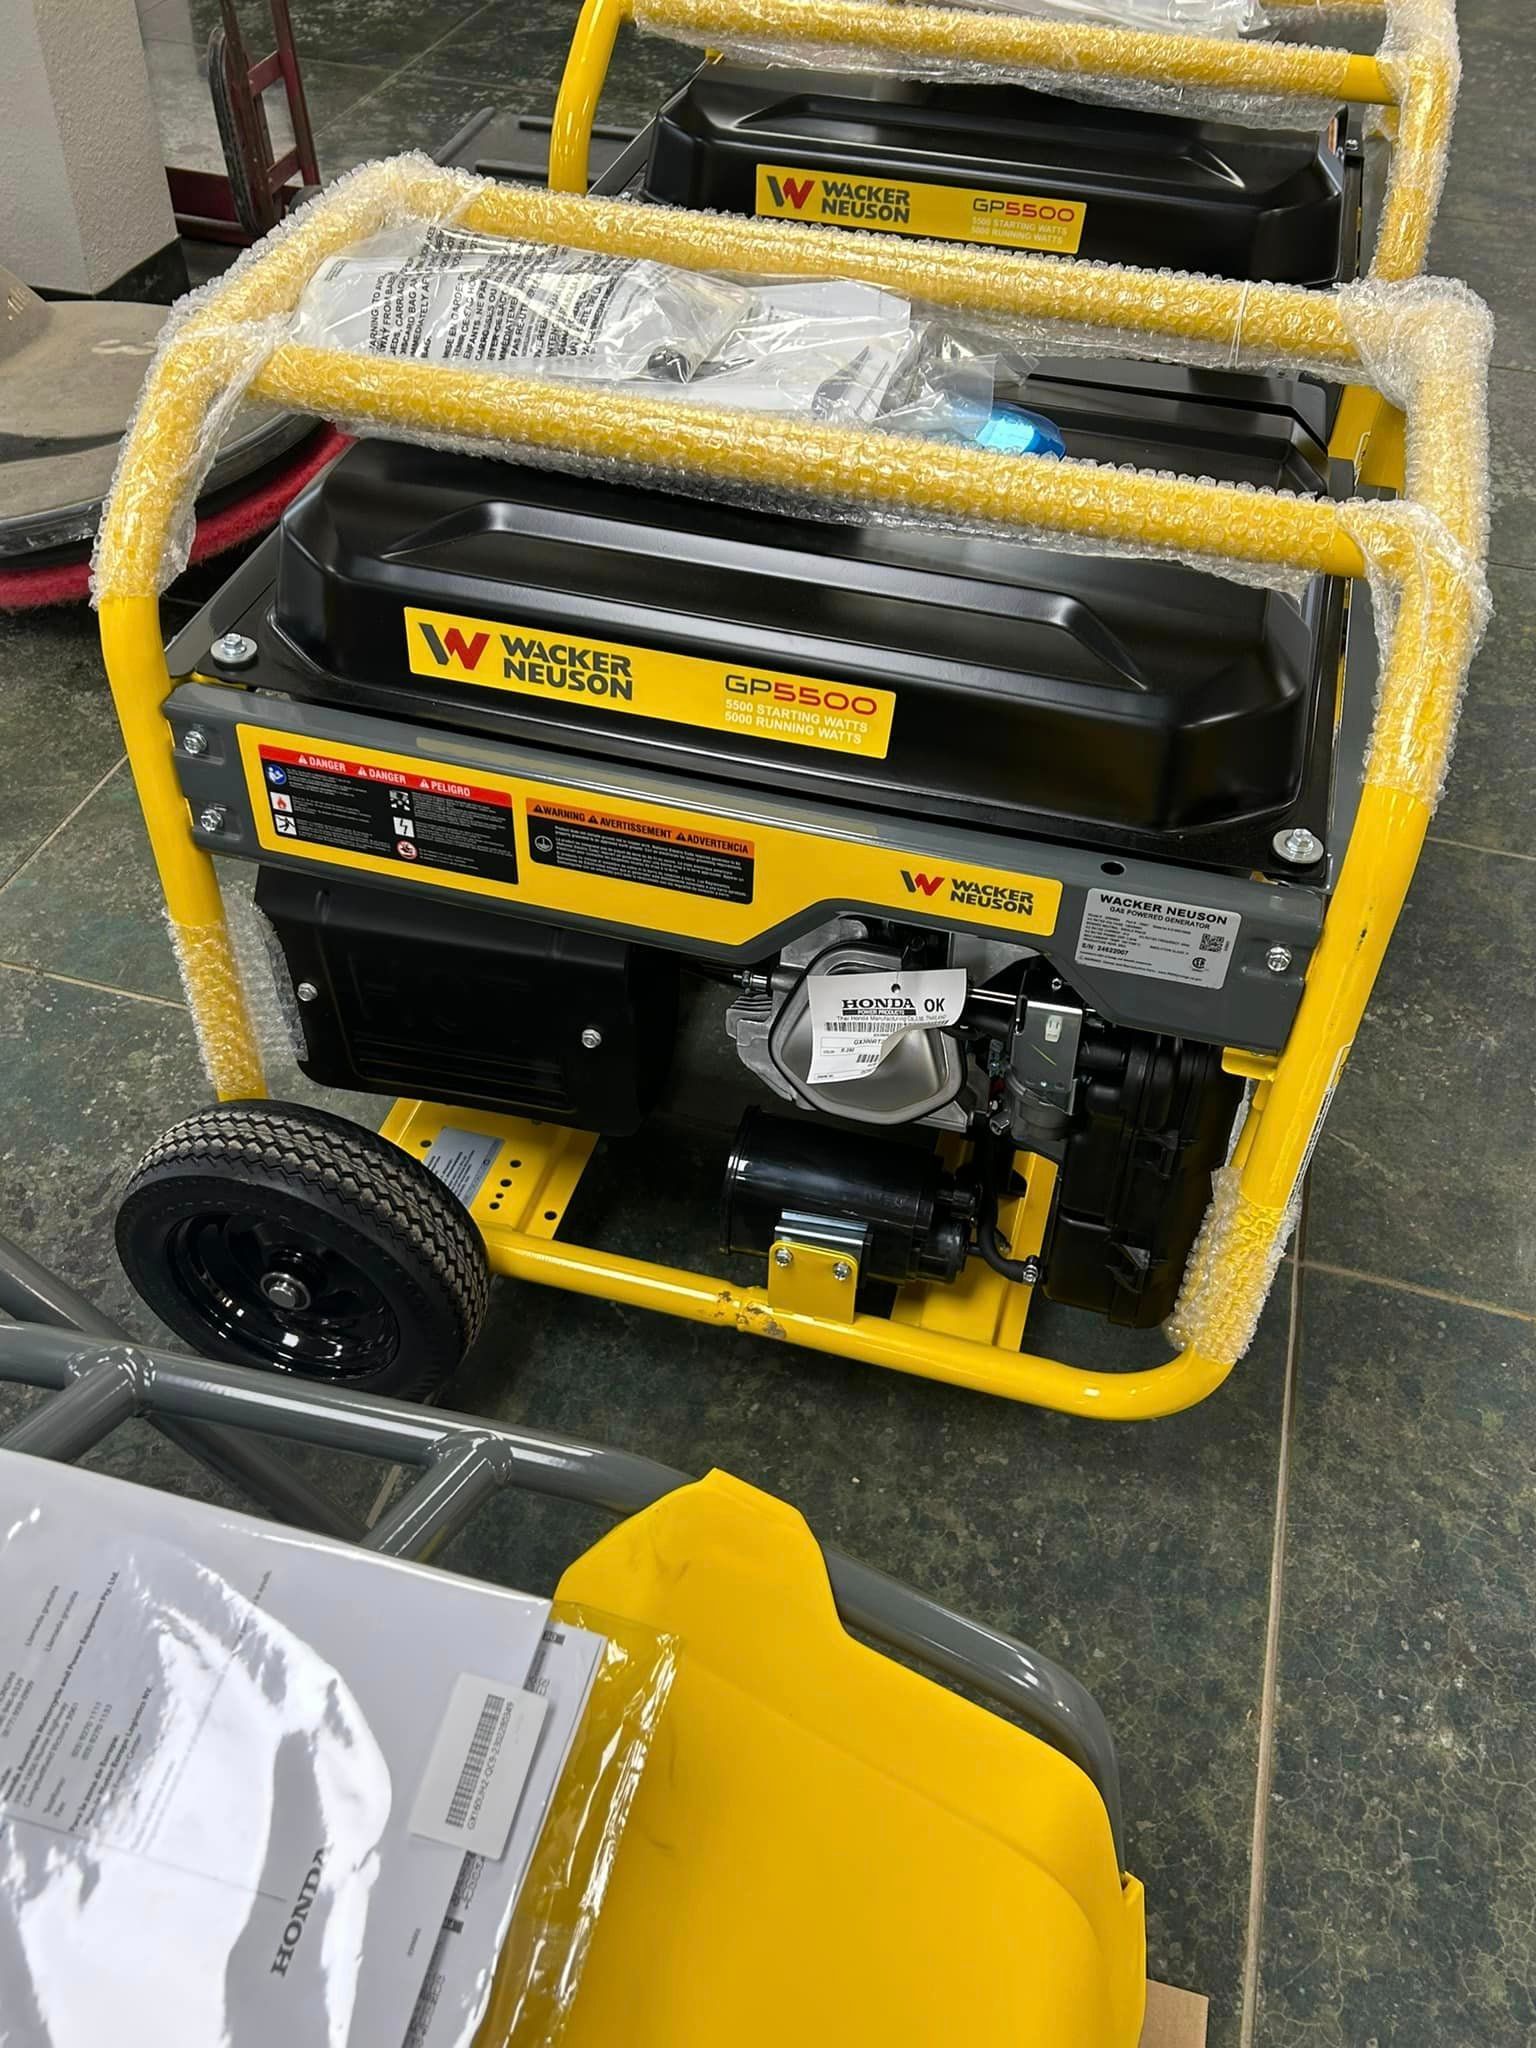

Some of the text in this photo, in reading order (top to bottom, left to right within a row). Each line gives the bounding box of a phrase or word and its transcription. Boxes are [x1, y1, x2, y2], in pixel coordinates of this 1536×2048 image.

[822, 181, 910, 206] WACKER
[822, 199, 910, 224] NEUSON
[973, 198, 1074, 222] GP5500
[992, 227, 1033, 242] RUNNING
[1034, 233, 1063, 244] WATTS
[994, 219, 1040, 232] STARTING
[1041, 225, 1068, 236] WATTS
[500, 635, 632, 677] WACKER
[504, 658, 632, 700] NEUSON
[725, 674, 877, 715] GP5500
[725, 699, 868, 733] 5500 STARTING WATTS
[725, 712, 862, 744] 5000 RUNNING WATTS
[309, 757, 346, 772] DANGER
[369, 768, 406, 784] DANGER
[431, 781, 470, 797] PELIGRO
[543, 805, 585, 822] WARNING
[600, 818, 672, 839] AVERTISSEMENT
[688, 834, 748, 853] ADVERTENCIA
[951, 878, 1034, 904] WACKER
[951, 890, 1033, 915] NEUSON
[1100, 894, 1162, 914] WACKER
[1166, 904, 1227, 926] NEUSON
[1110, 906, 1125, 915] GAS
[1127, 909, 1162, 922] POWERED
[1165, 916, 1210, 930] GENERATOR
[842, 998, 945, 1012] HONDA OK
[36, 1686, 64, 1733] Motorcycle
[59, 1669, 71, 1686] and
[67, 1644, 84, 1670] Power
[79, 1601, 105, 1644] Equipment
[124, 1699, 147, 1738] Logistics
[270, 1841, 329, 1978] HONDA
